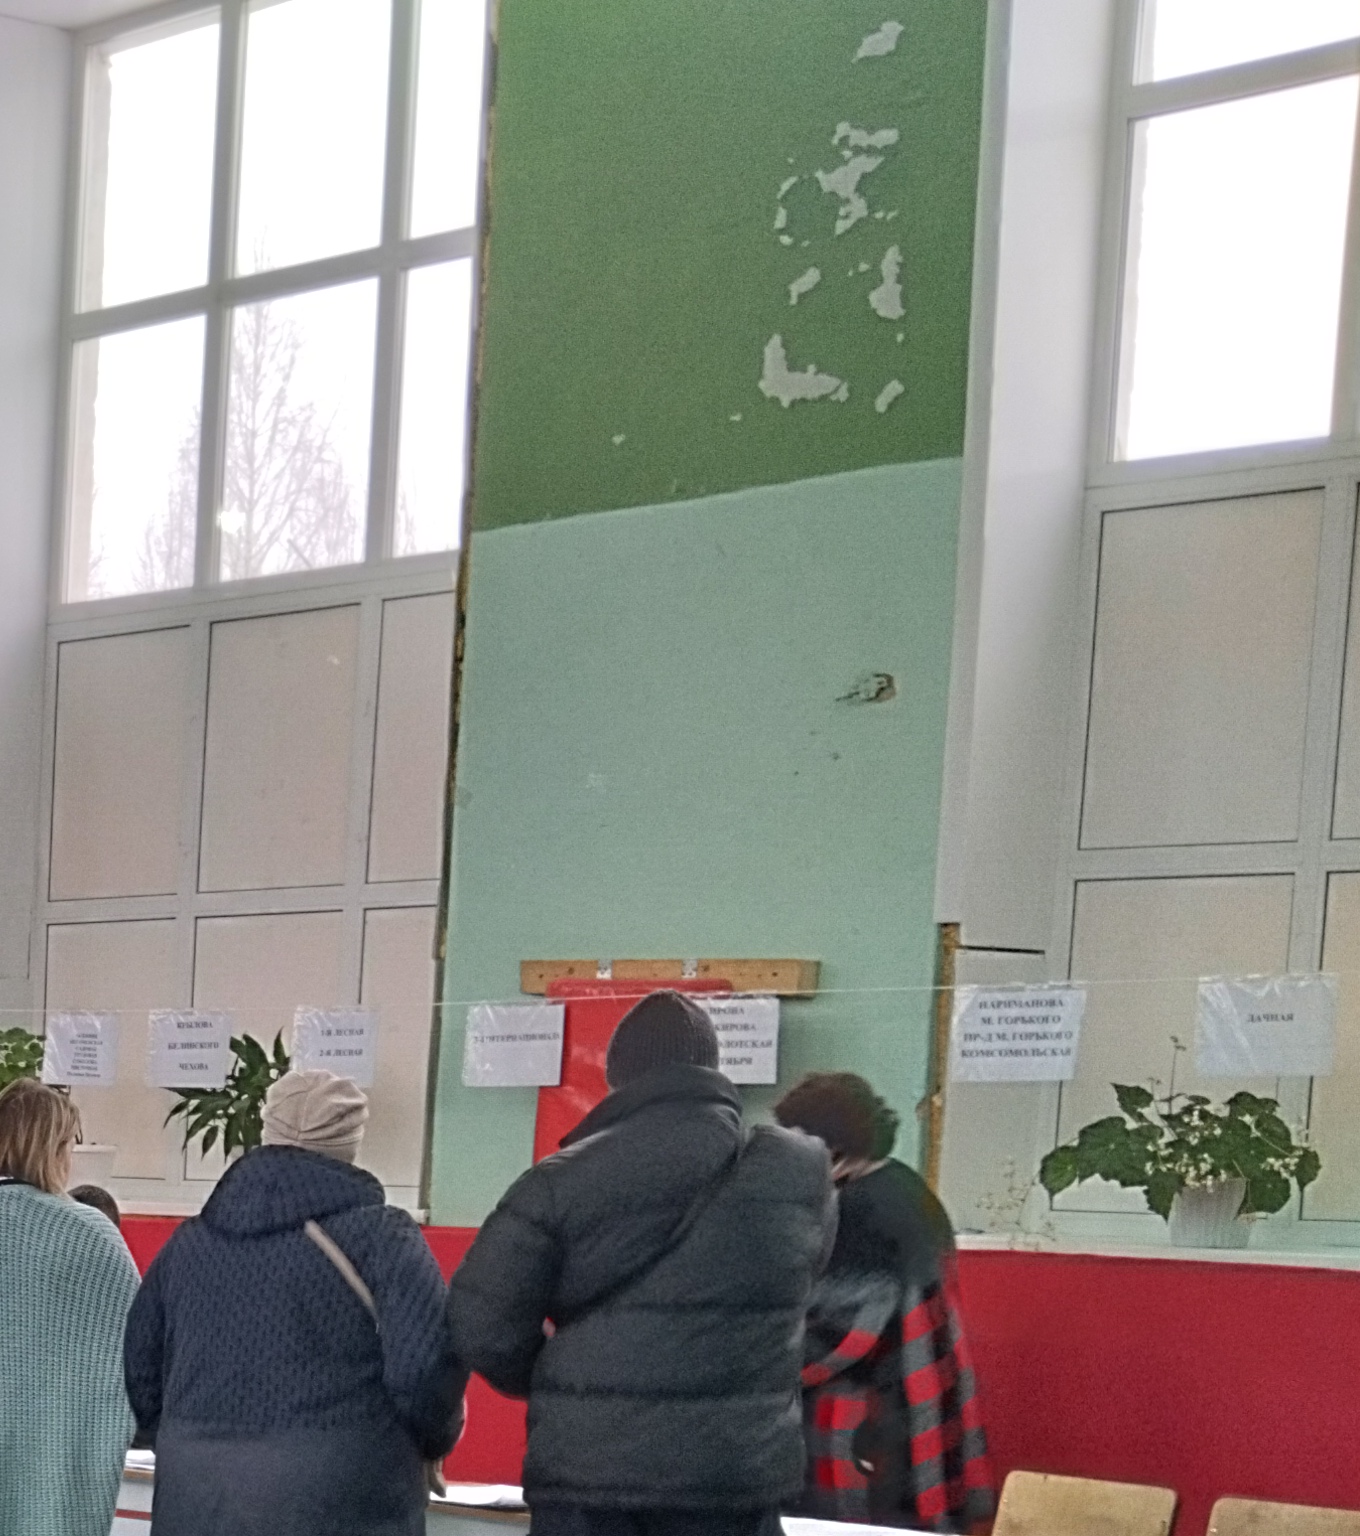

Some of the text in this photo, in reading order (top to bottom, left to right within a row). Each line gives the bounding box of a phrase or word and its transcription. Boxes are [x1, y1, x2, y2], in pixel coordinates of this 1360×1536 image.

[979, 999, 1064, 1009] НАРИМАНОВА
[998, 1015, 1061, 1025] ГОРЬКОГО
[1247, 1013, 1294, 1023] ДАЧНАЯ
[1012, 1031, 1073, 1041] ГОРЬКОГО
[961, 1048, 1071, 1058] КОМСОМОЛЬСКАЯ
